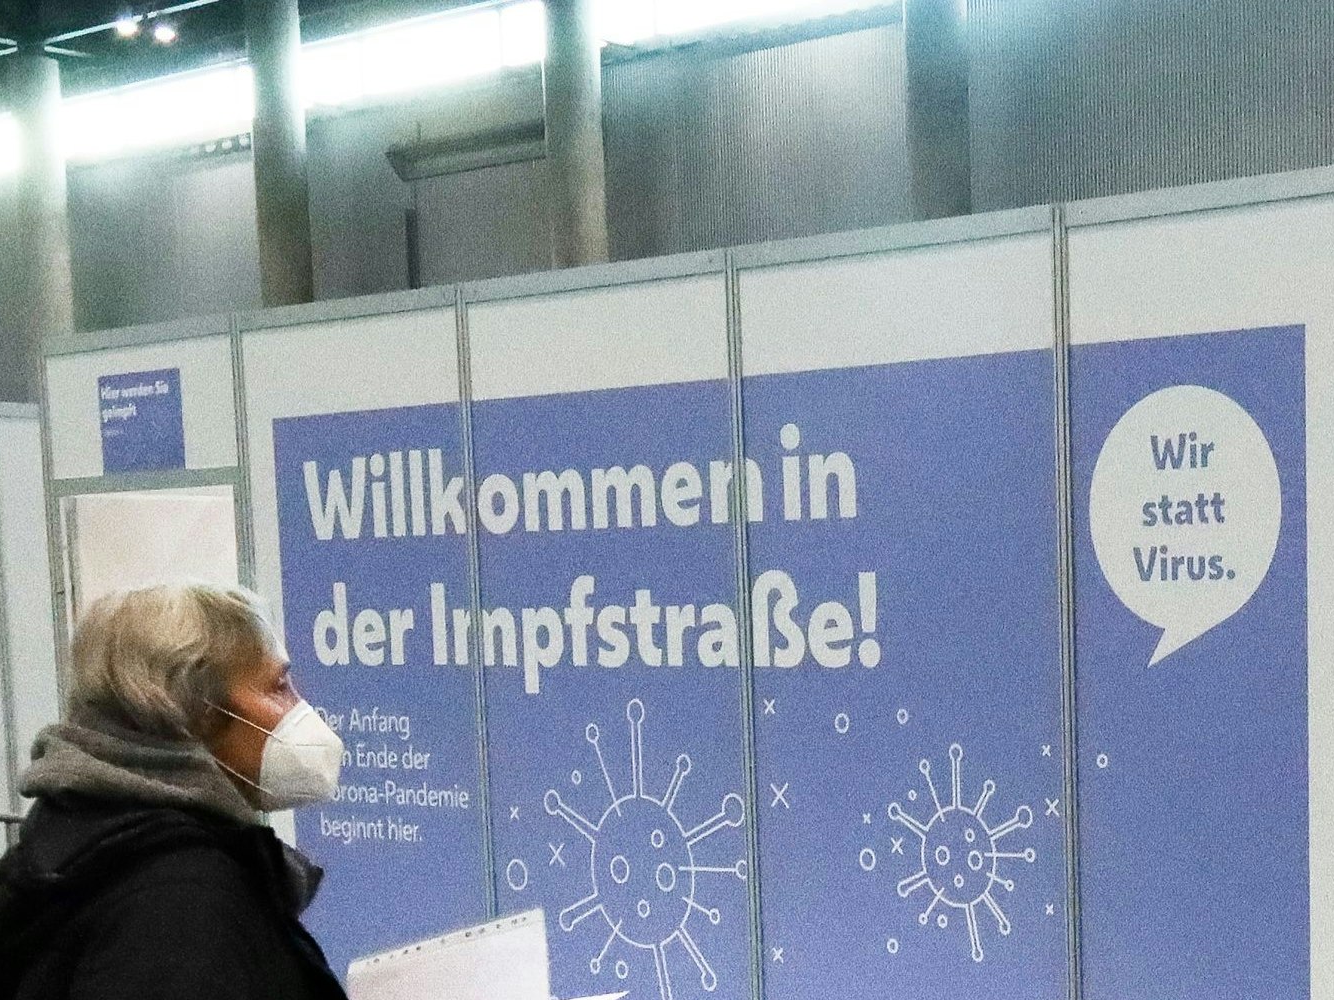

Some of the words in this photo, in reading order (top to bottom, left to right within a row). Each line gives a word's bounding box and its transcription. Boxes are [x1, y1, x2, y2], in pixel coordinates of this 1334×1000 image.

[1149, 431, 1215, 471] Wir
[303, 447, 763, 541] Willkommen
[779, 422, 857, 521] in
[1142, 492, 1226, 527] statt
[1133, 544, 1236, 582] Virus.
[313, 582, 415, 668] der
[430, 569, 881, 694] Impfstraße!
[349, 706, 411, 740] Anfang
[356, 742, 398, 768] Ende
[402, 744, 431, 770] der
[332, 780, 469, 809] orona-Pandemie
[320, 812, 385, 845] beginnt
[388, 815, 423, 843] hier.
